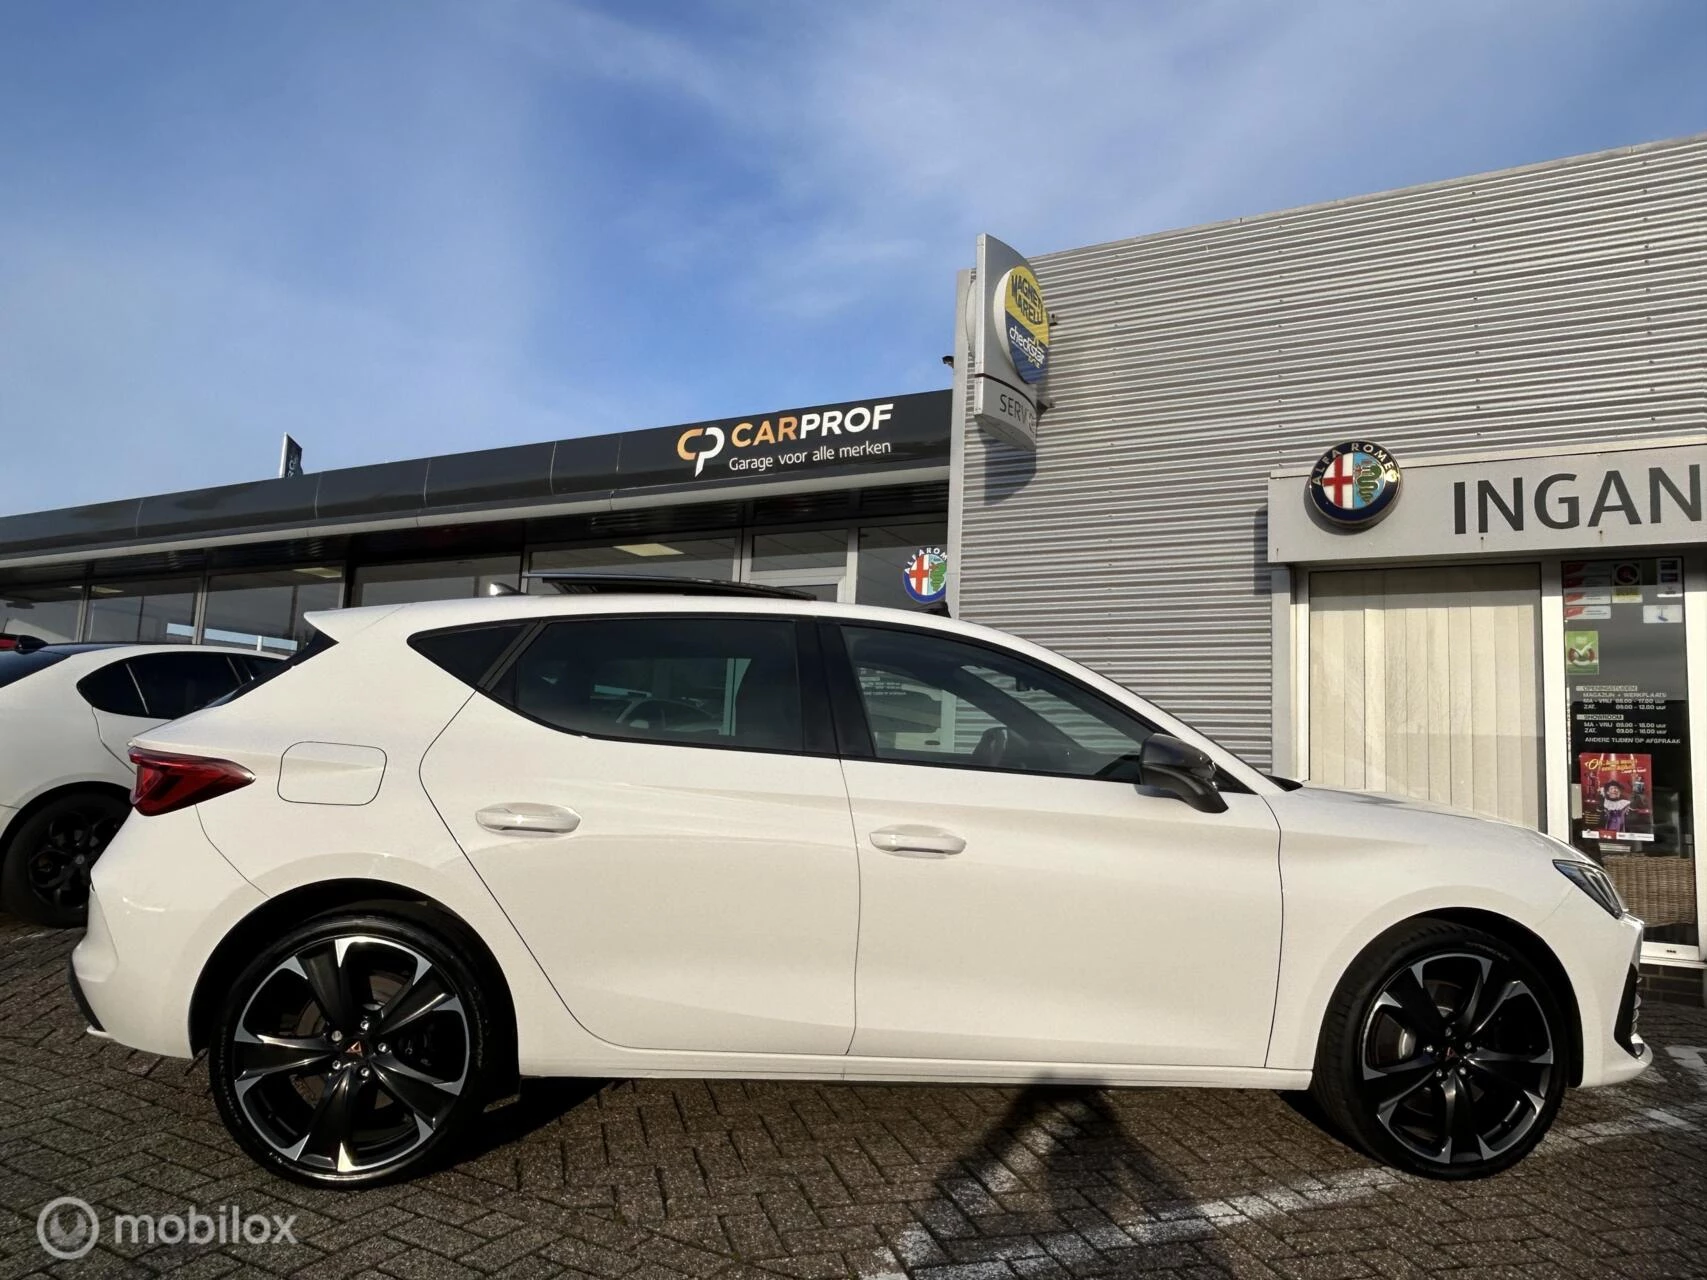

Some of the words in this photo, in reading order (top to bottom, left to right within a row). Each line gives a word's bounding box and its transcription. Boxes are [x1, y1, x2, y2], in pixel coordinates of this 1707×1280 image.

[1009, 326, 1045, 365] checkstar
[731, 403, 894, 448] CARPROF
[729, 457, 773, 472] Garage
[779, 452, 807, 465] voor
[812, 446, 835, 462] alle
[840, 441, 891, 458] merken
[1312, 449, 1341, 485] ALFA
[1351, 443, 1398, 482] ROMEO
[1453, 464, 1703, 535] INGAN
[904, 549, 925, 574] ALFA
